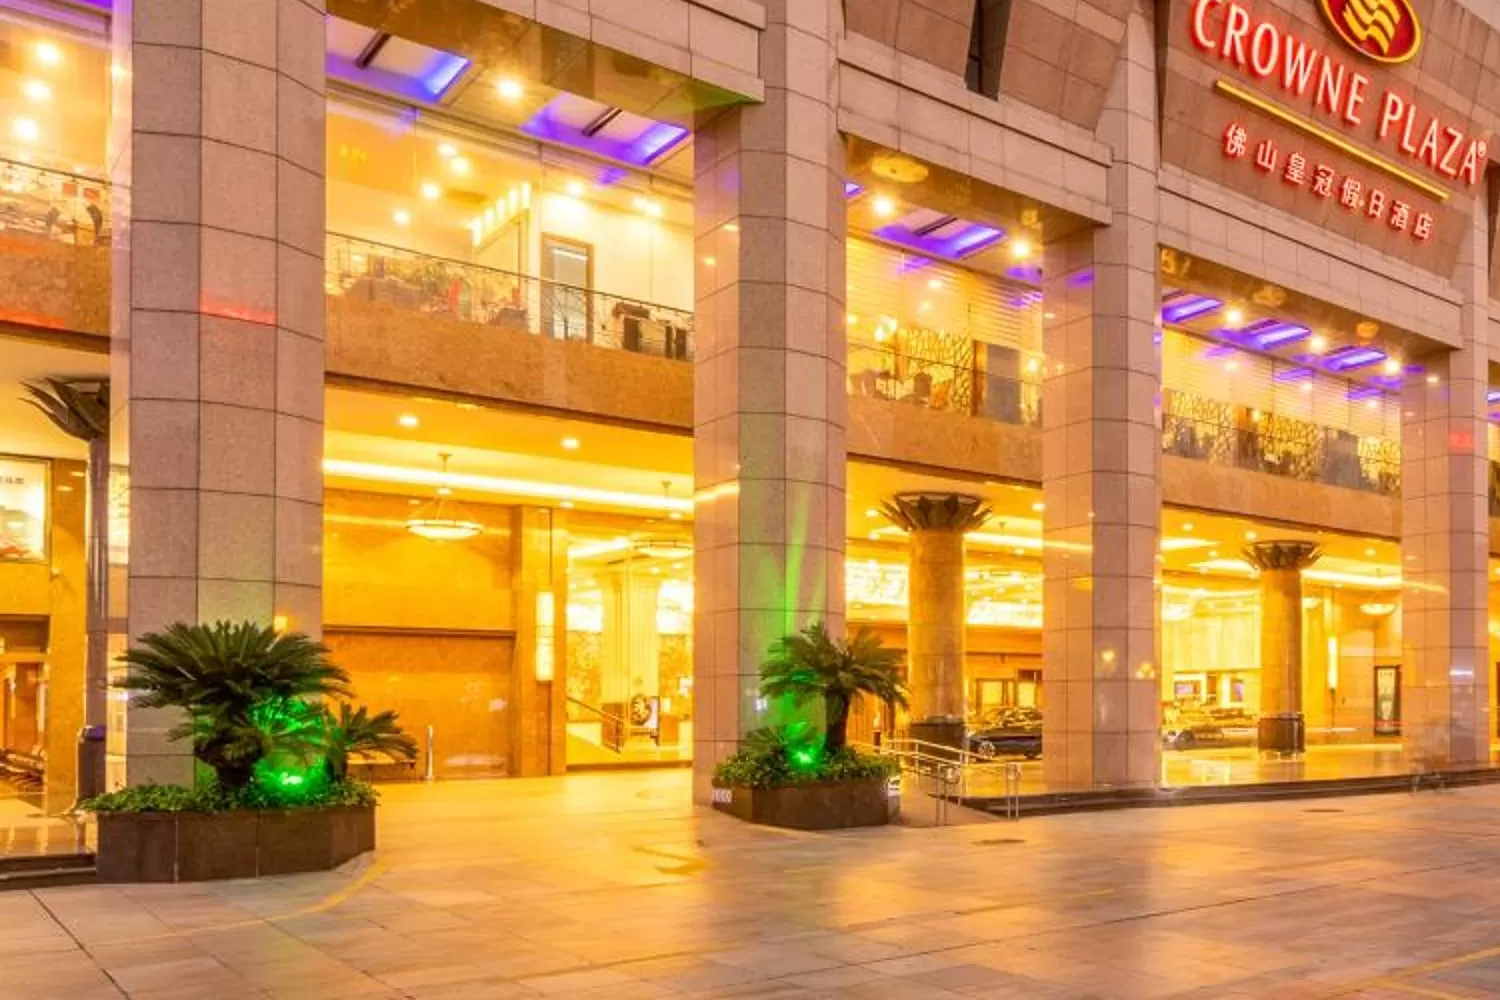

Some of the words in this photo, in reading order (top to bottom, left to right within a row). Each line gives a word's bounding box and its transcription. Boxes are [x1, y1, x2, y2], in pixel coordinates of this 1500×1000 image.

[1224, 122, 1434, 241] 佛山皇冠假日酒店
